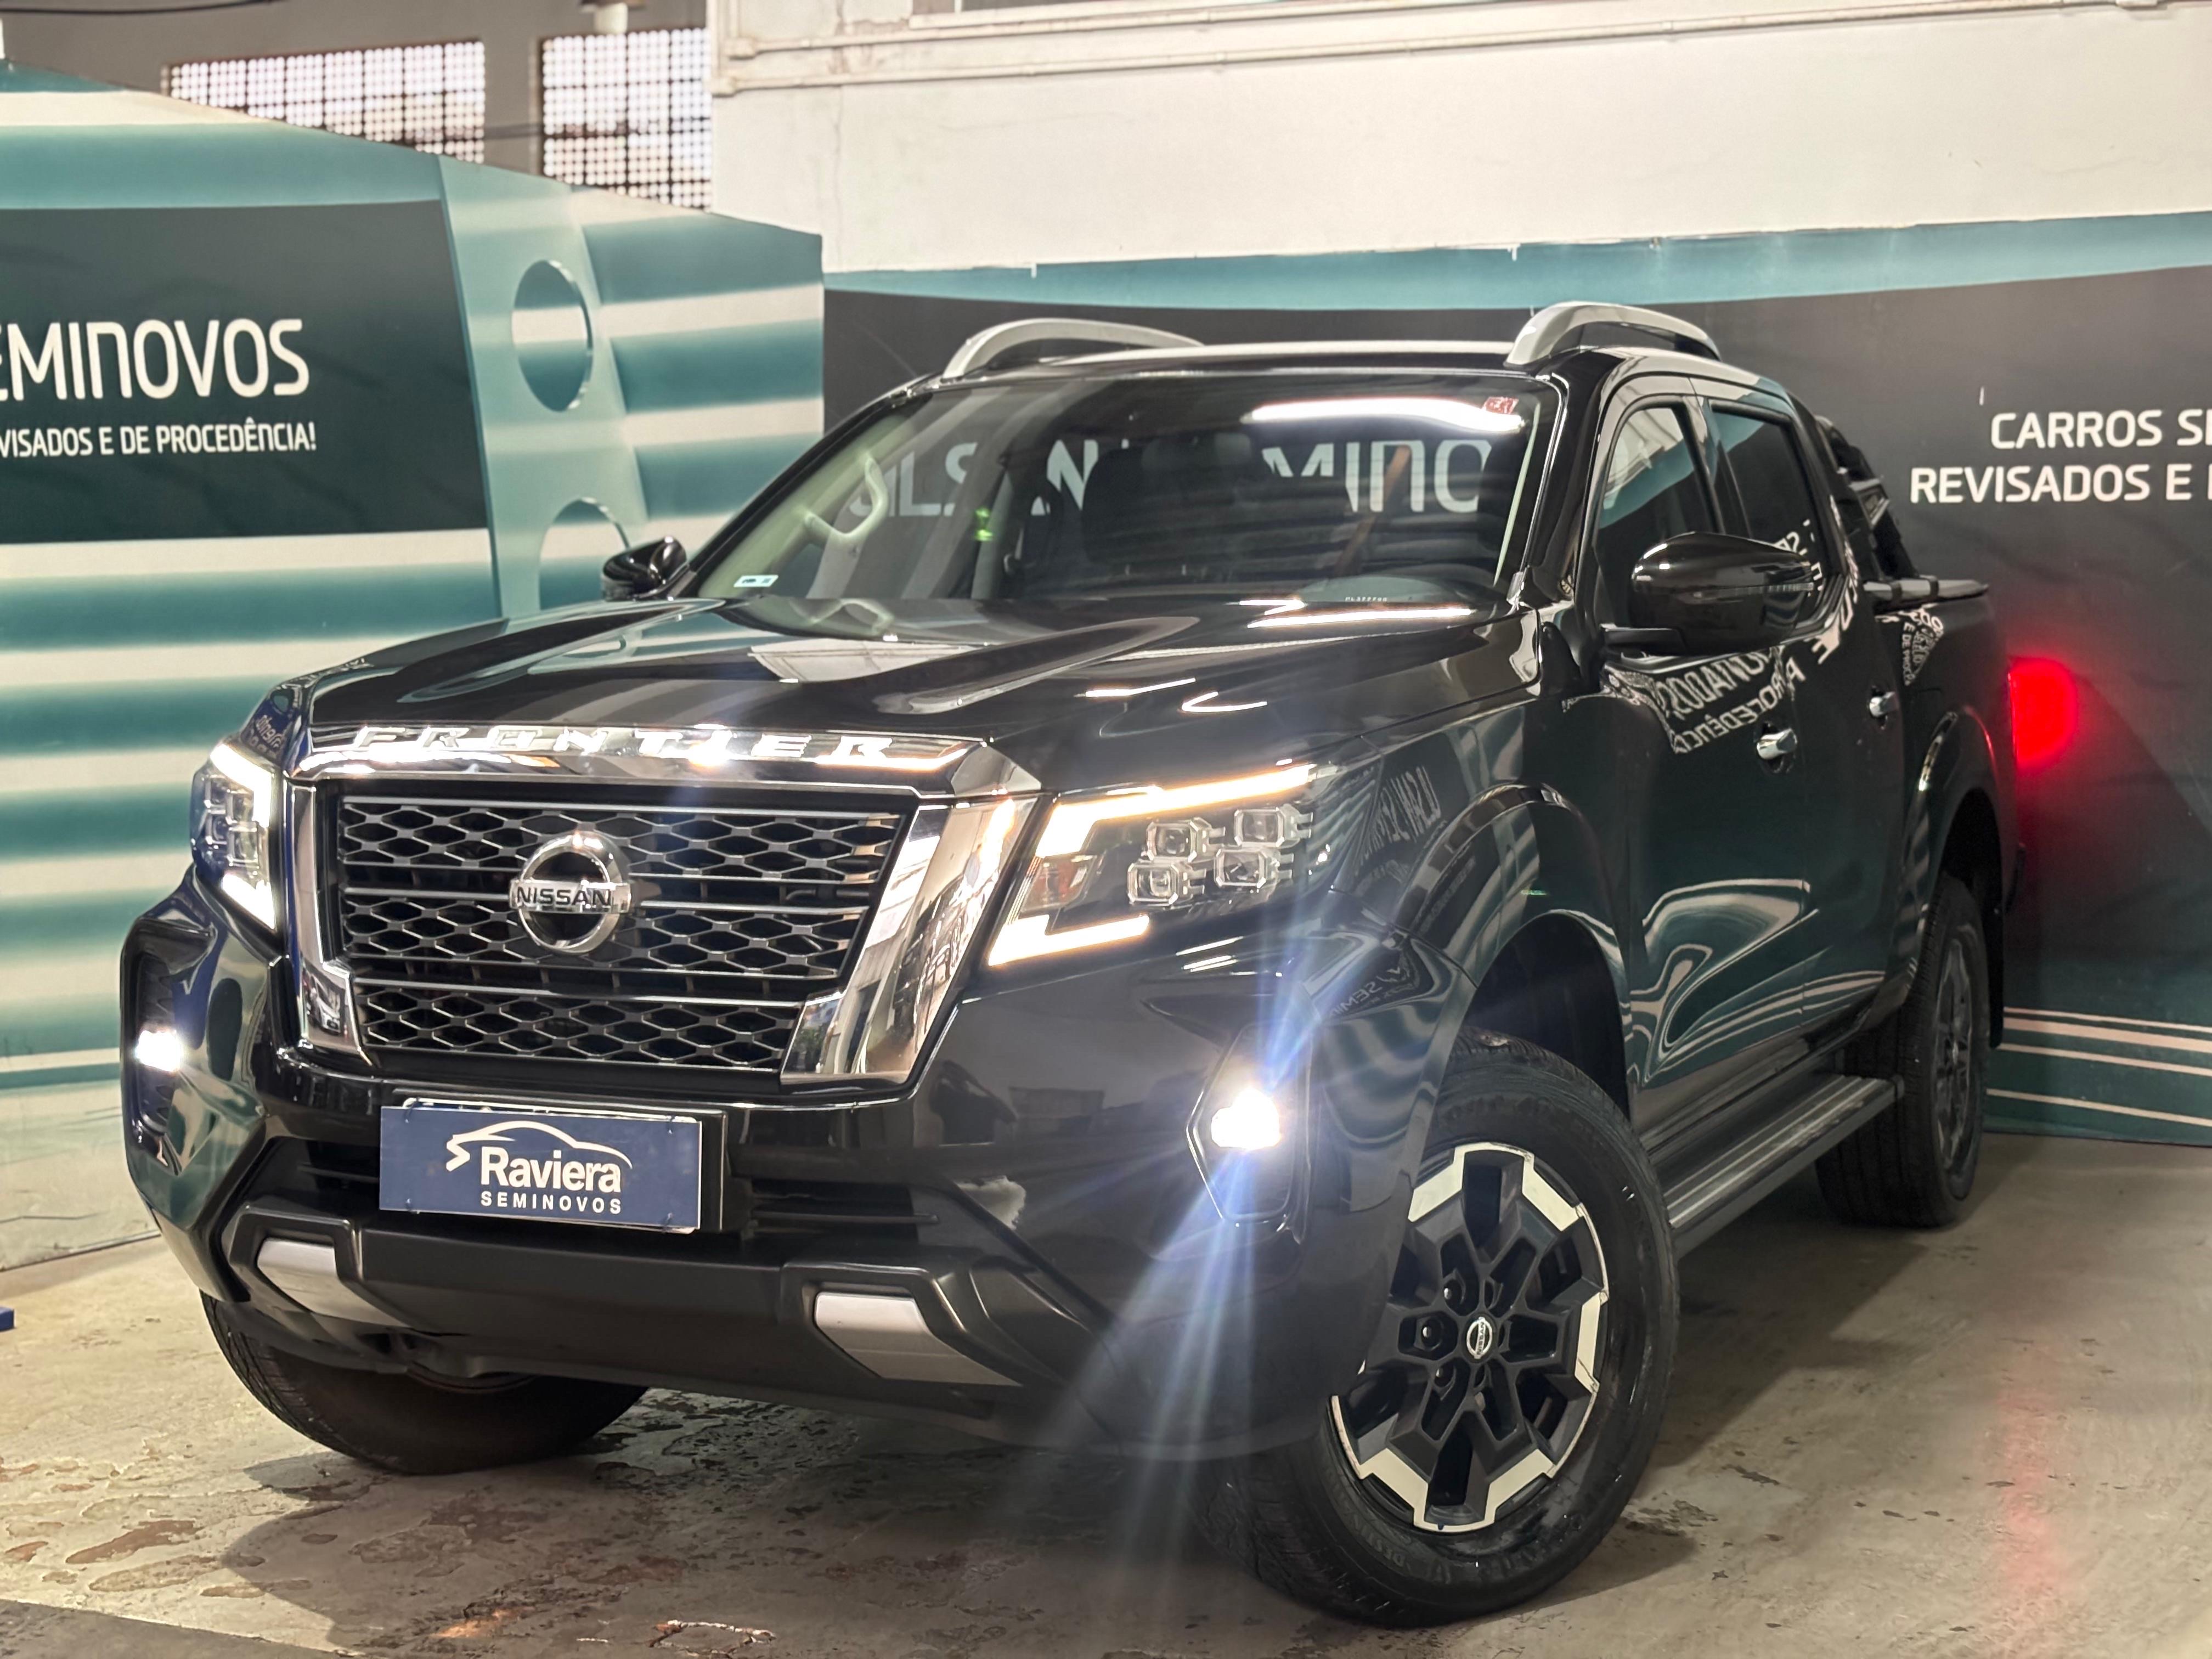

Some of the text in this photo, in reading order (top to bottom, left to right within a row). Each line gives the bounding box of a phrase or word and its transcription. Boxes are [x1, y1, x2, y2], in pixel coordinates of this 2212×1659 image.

[99, 427, 114, 455] E
[120, 426, 150, 454] DE
[156, 416, 317, 453] PROCEDÊNCIA!
[1991, 410, 2163, 448] CARROS
[1910, 464, 2151, 503] REVISADOS
[2166, 464, 2192, 500] E
[353, 725, 894, 758] FRONTIER
[517, 886, 612, 906] NISSAN
[481, 1146, 622, 1193] Raviera
[481, 1190, 622, 1215] SEMINOVOS
